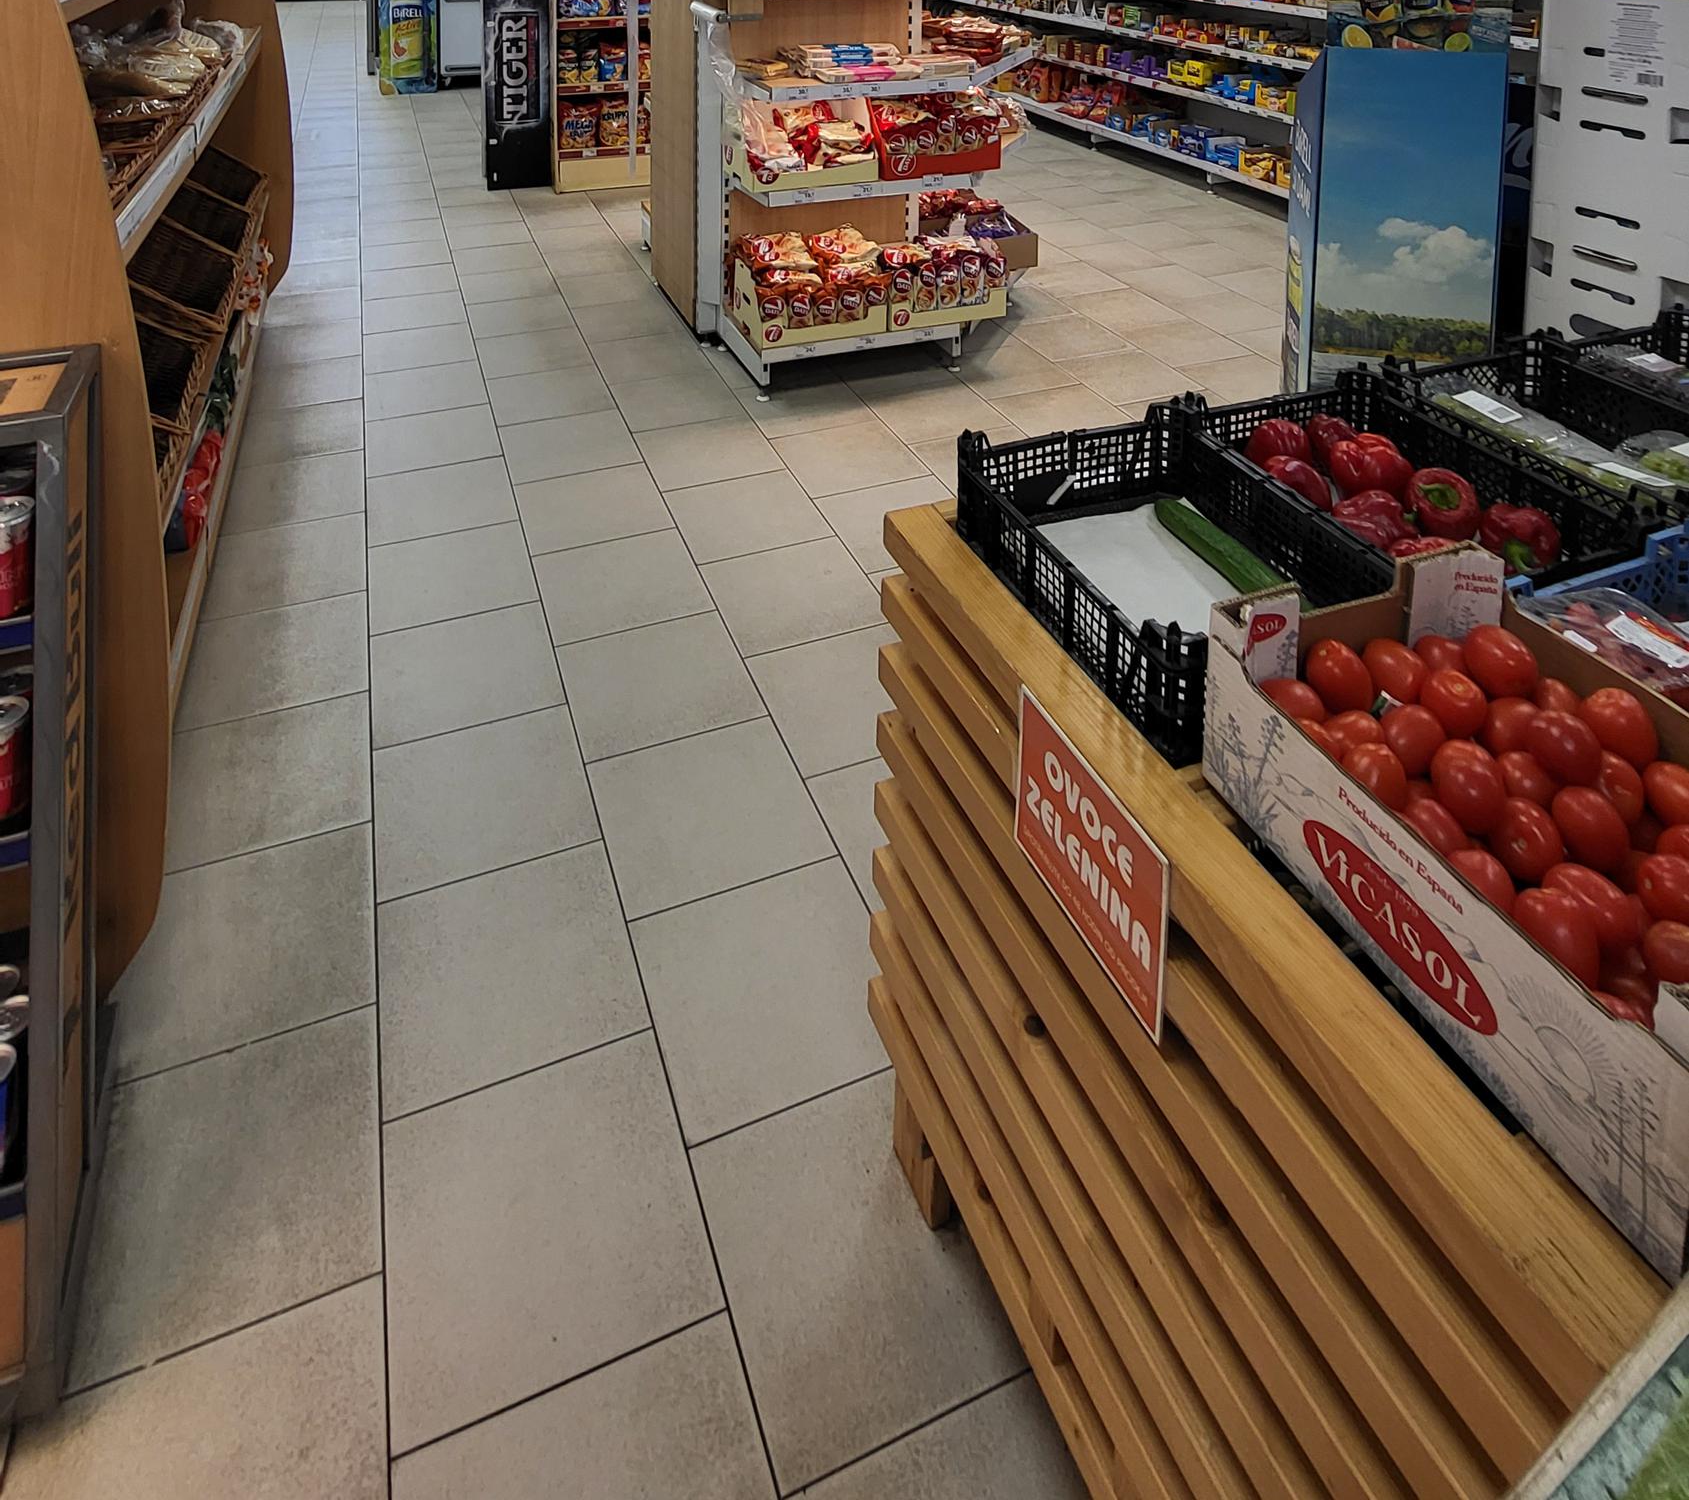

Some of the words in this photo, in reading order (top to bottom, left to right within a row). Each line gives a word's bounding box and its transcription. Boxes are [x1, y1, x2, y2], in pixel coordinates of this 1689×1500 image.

[503, 16, 527, 119] TIGER
[1026, 776, 1150, 973] ZELENINA
[1044, 750, 1133, 888] OVOCE
[1338, 786, 1397, 851] Producido
[1398, 847, 1415, 869] en
[1416, 859, 1464, 916] España
